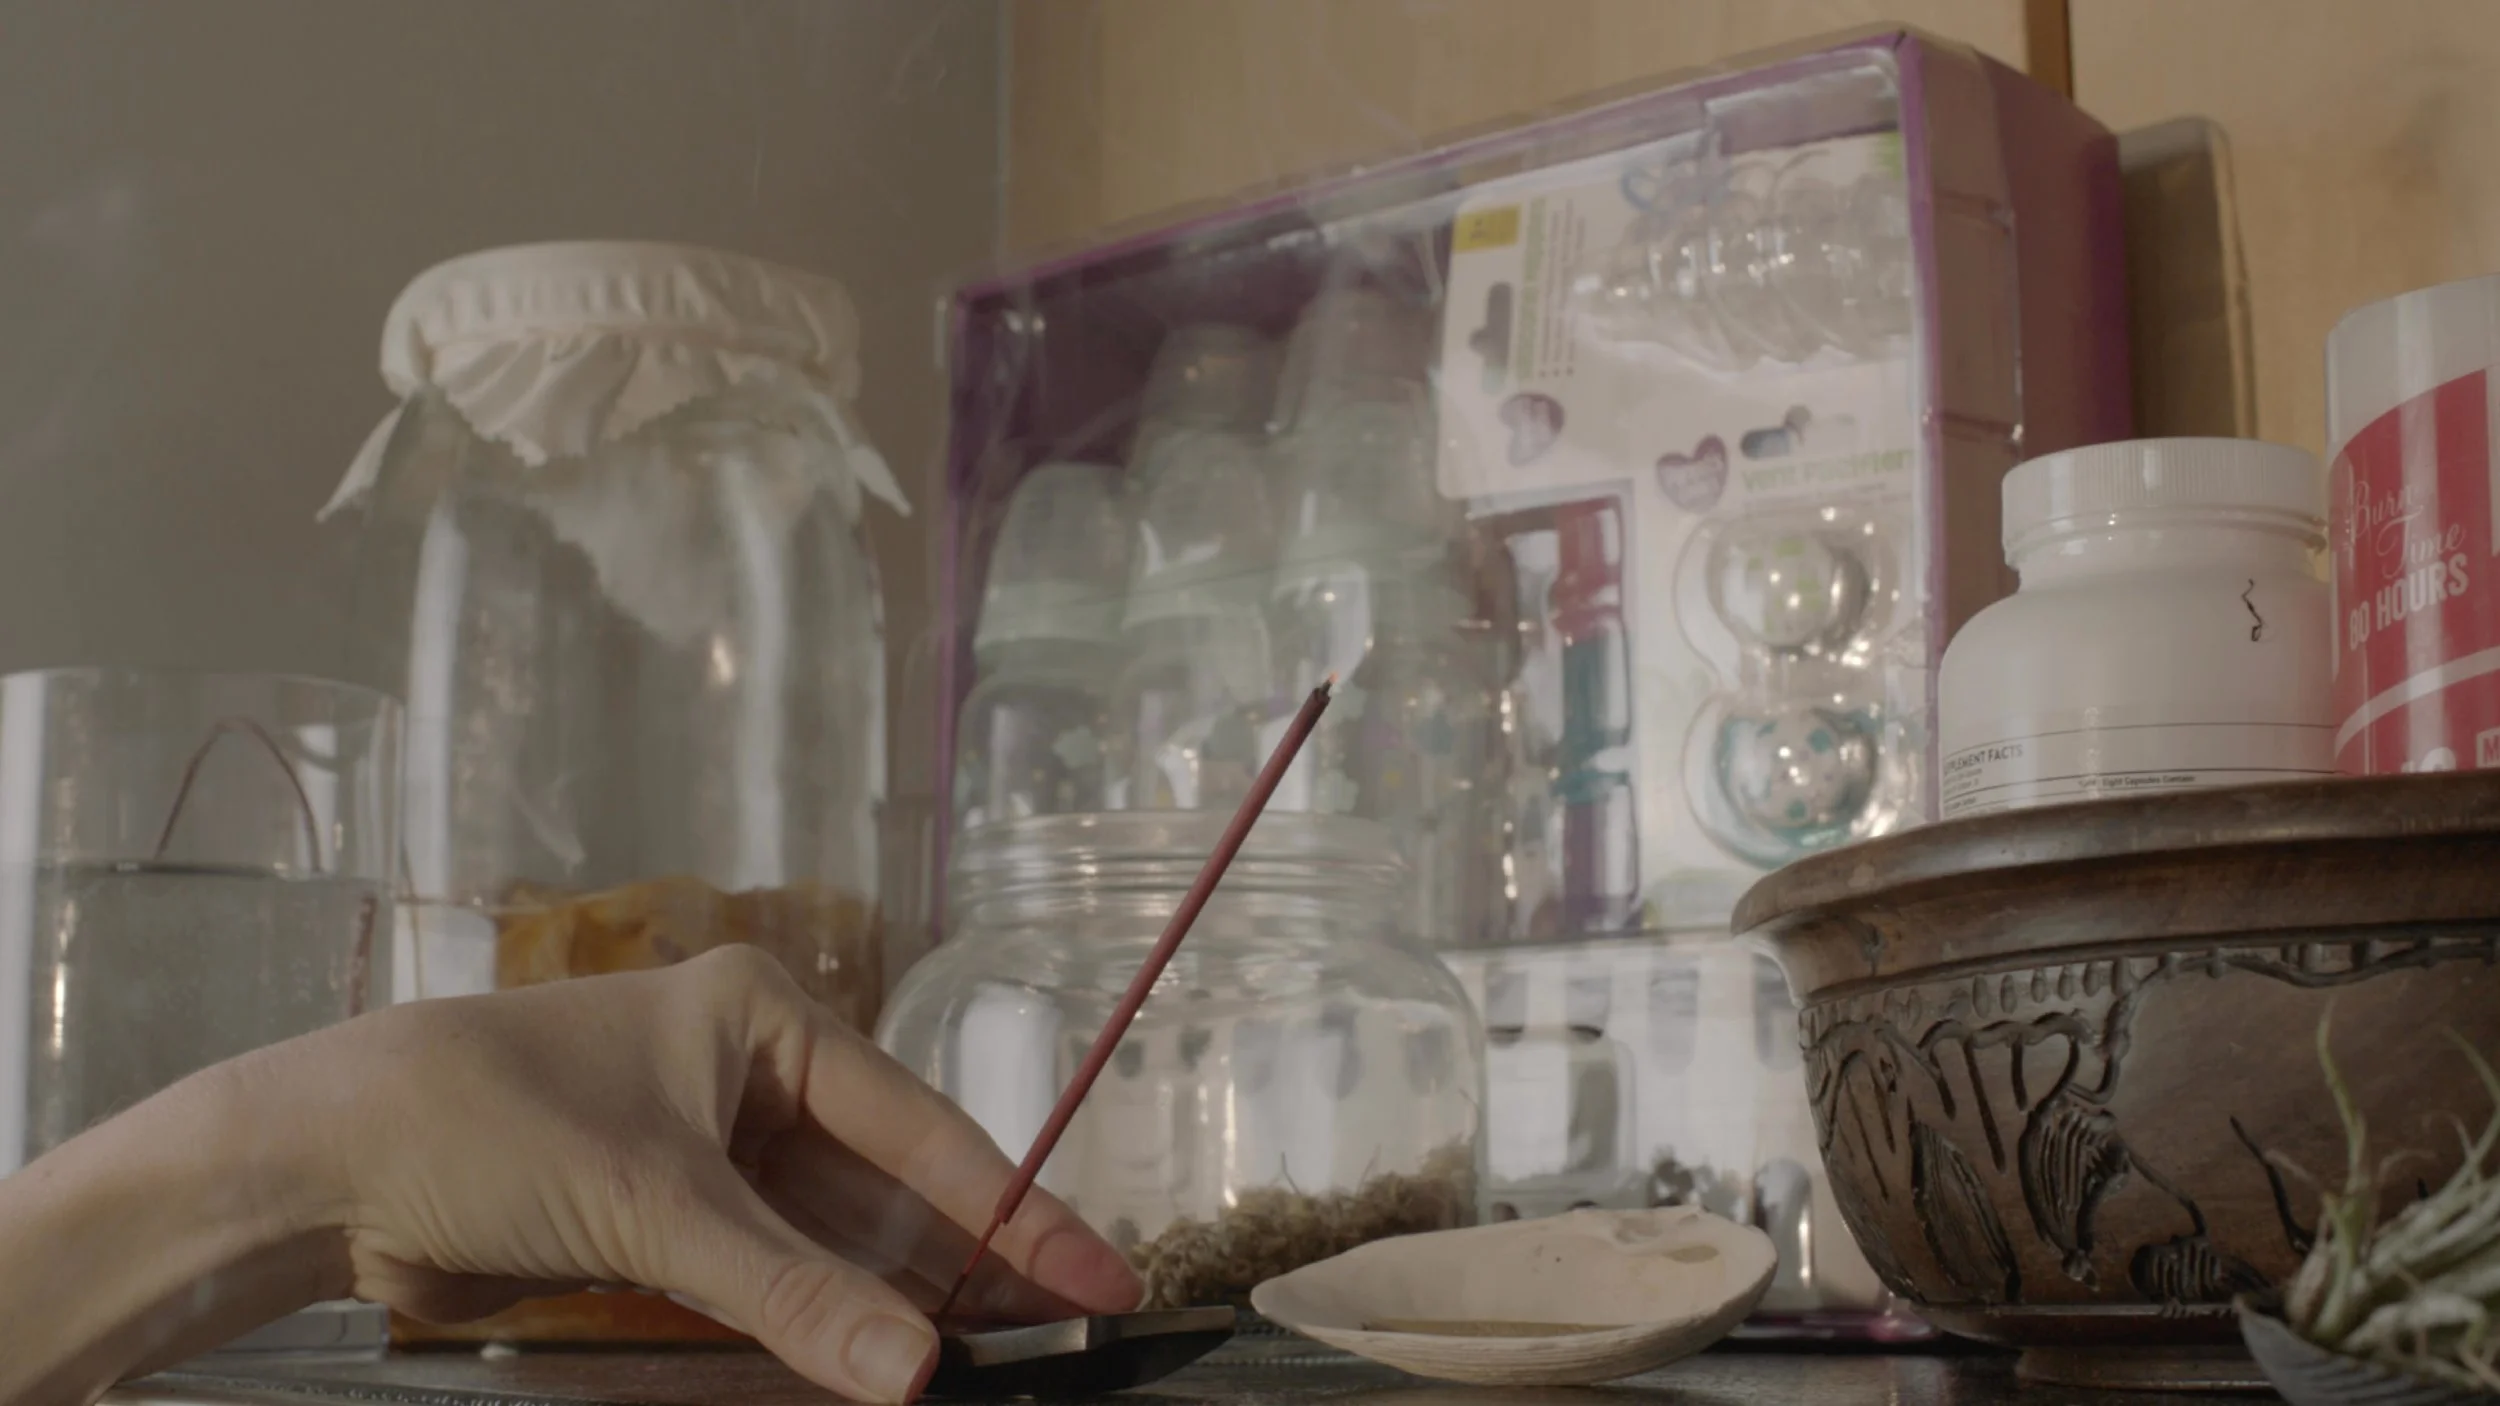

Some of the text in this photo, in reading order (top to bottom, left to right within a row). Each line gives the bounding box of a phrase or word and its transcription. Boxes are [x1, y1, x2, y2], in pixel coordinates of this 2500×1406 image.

[2376, 504, 2467, 580] Time
[2349, 552, 2470, 651] 80 HOURS
[1988, 744, 2022, 761] FACTS
